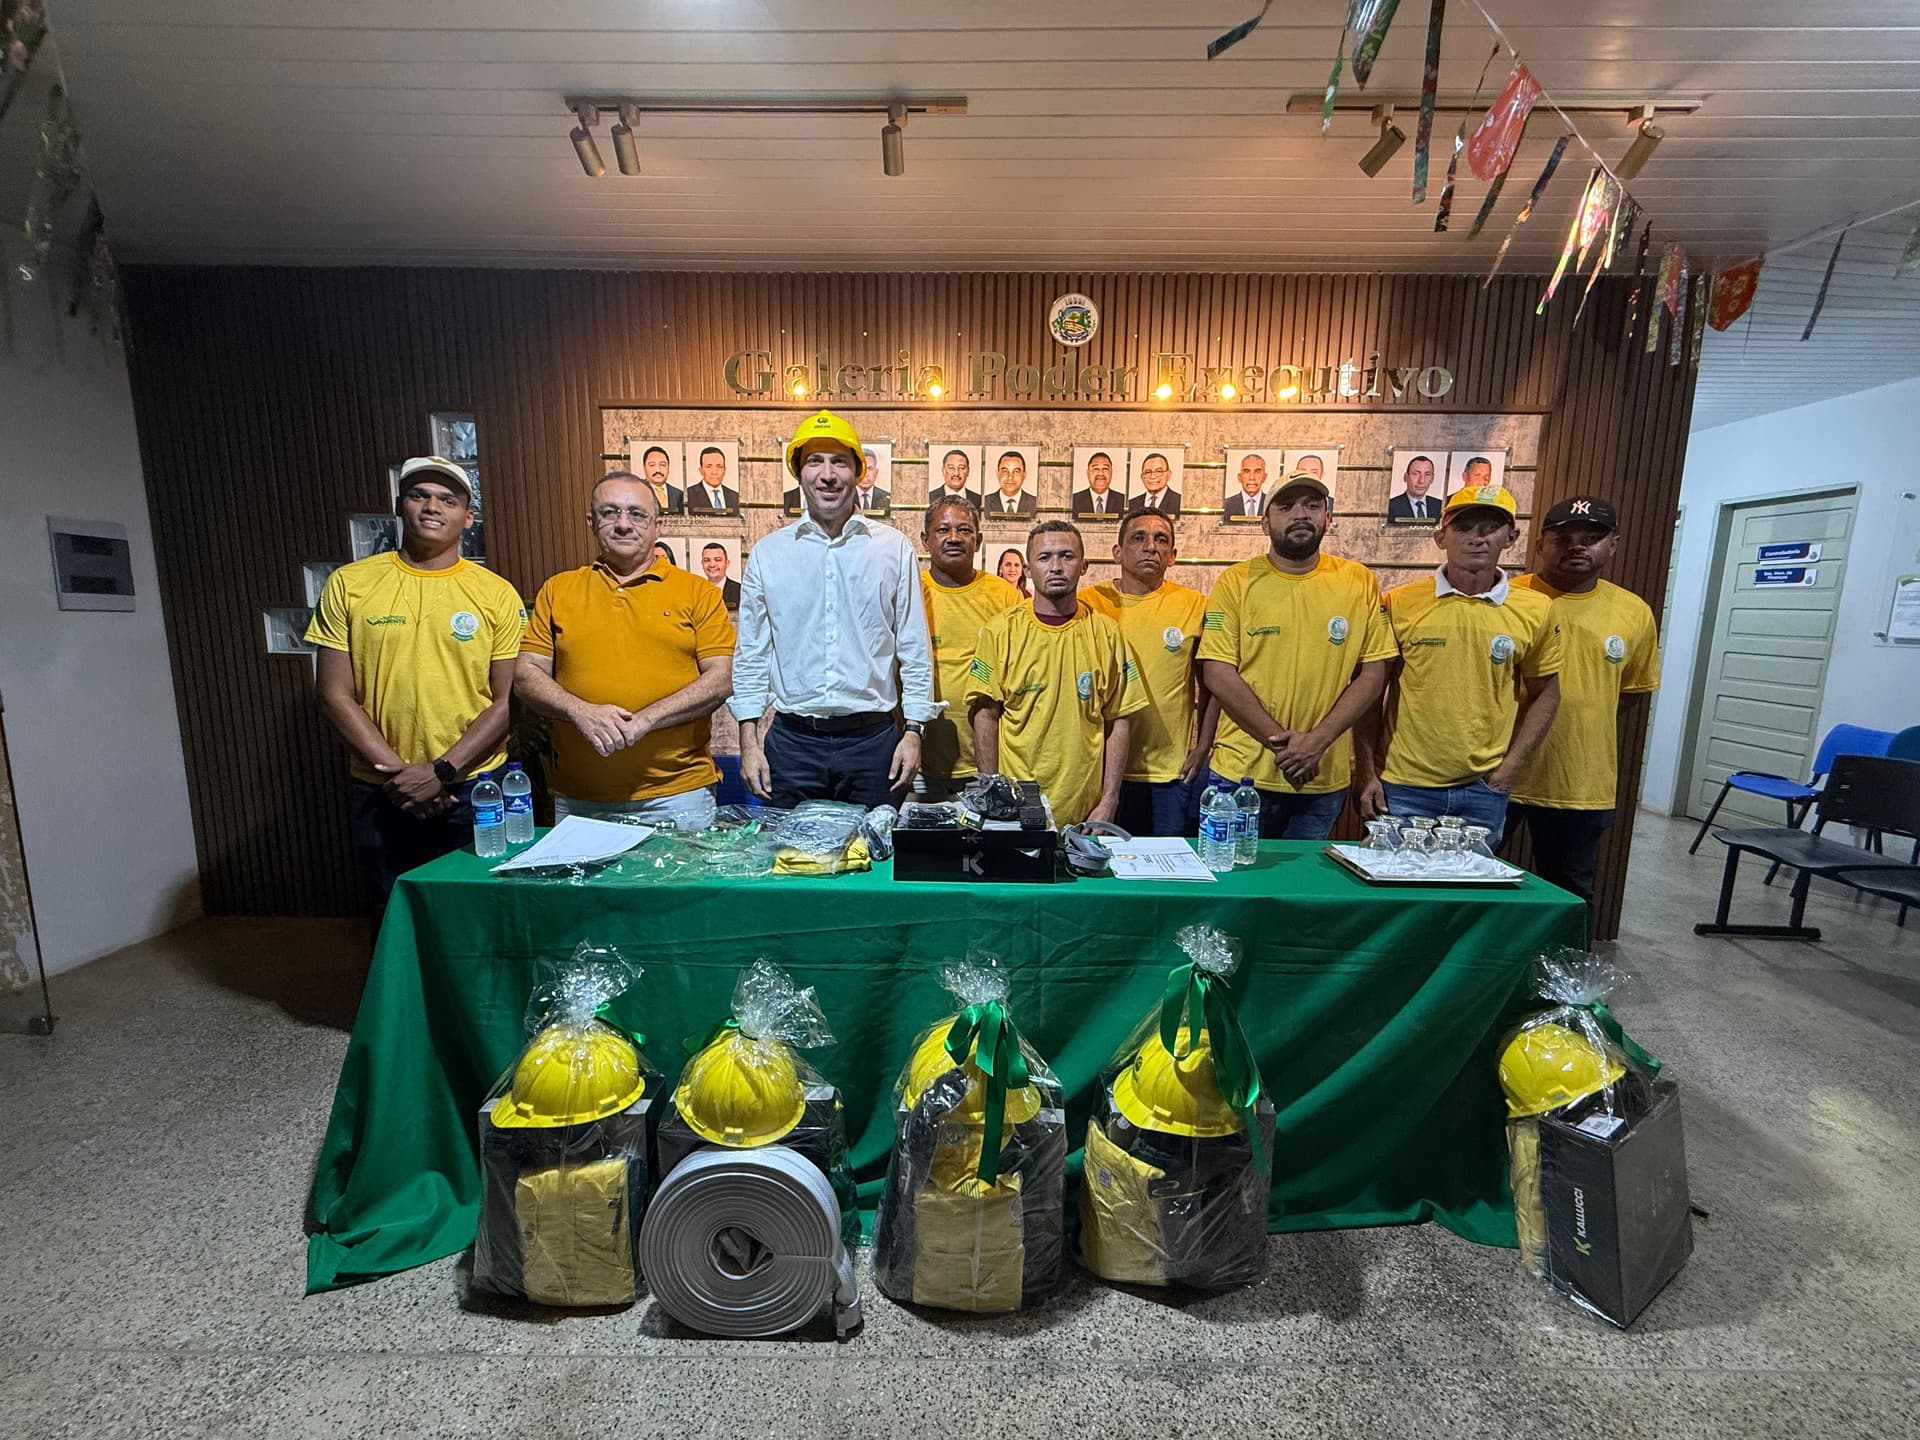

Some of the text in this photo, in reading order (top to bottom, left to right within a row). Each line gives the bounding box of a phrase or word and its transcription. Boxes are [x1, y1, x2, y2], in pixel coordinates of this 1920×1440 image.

[723, 349, 1454, 398] Galeria Poder Executivo
[1574, 1187, 1586, 1238] KALLUCCI
